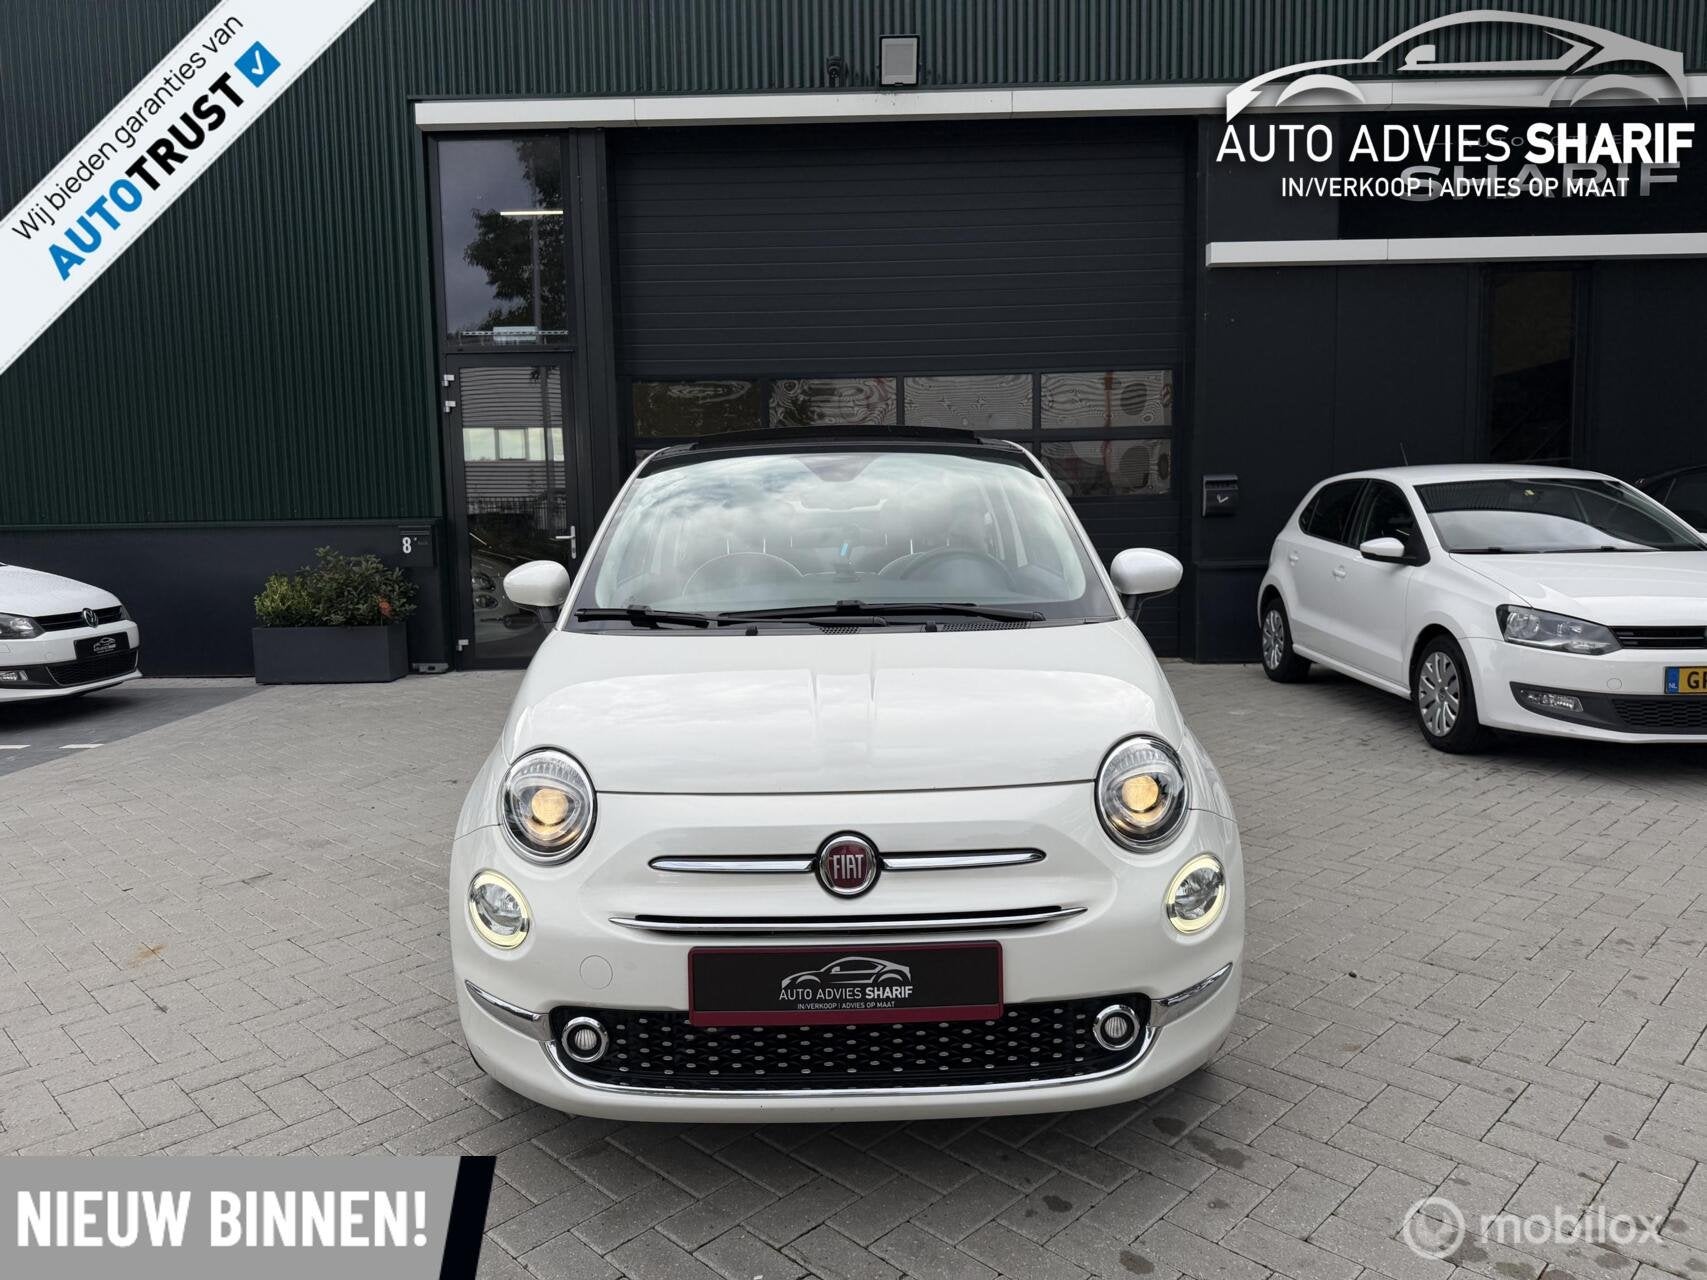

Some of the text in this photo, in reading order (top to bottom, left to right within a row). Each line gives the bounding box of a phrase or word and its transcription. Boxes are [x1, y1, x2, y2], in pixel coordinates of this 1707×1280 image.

[402, 537, 412, 554] 8
[1687, 671, 1707, 690] G
[833, 854, 864, 880] FIAT
[779, 986, 913, 1001] AUTO ADVIES SHARIF
[797, 1002, 837, 1010] IN/VERKOOP
[841, 1001, 865, 1009] ADVIES
[866, 1001, 876, 1009] OP
[876, 1000, 895, 1008] MAAT
